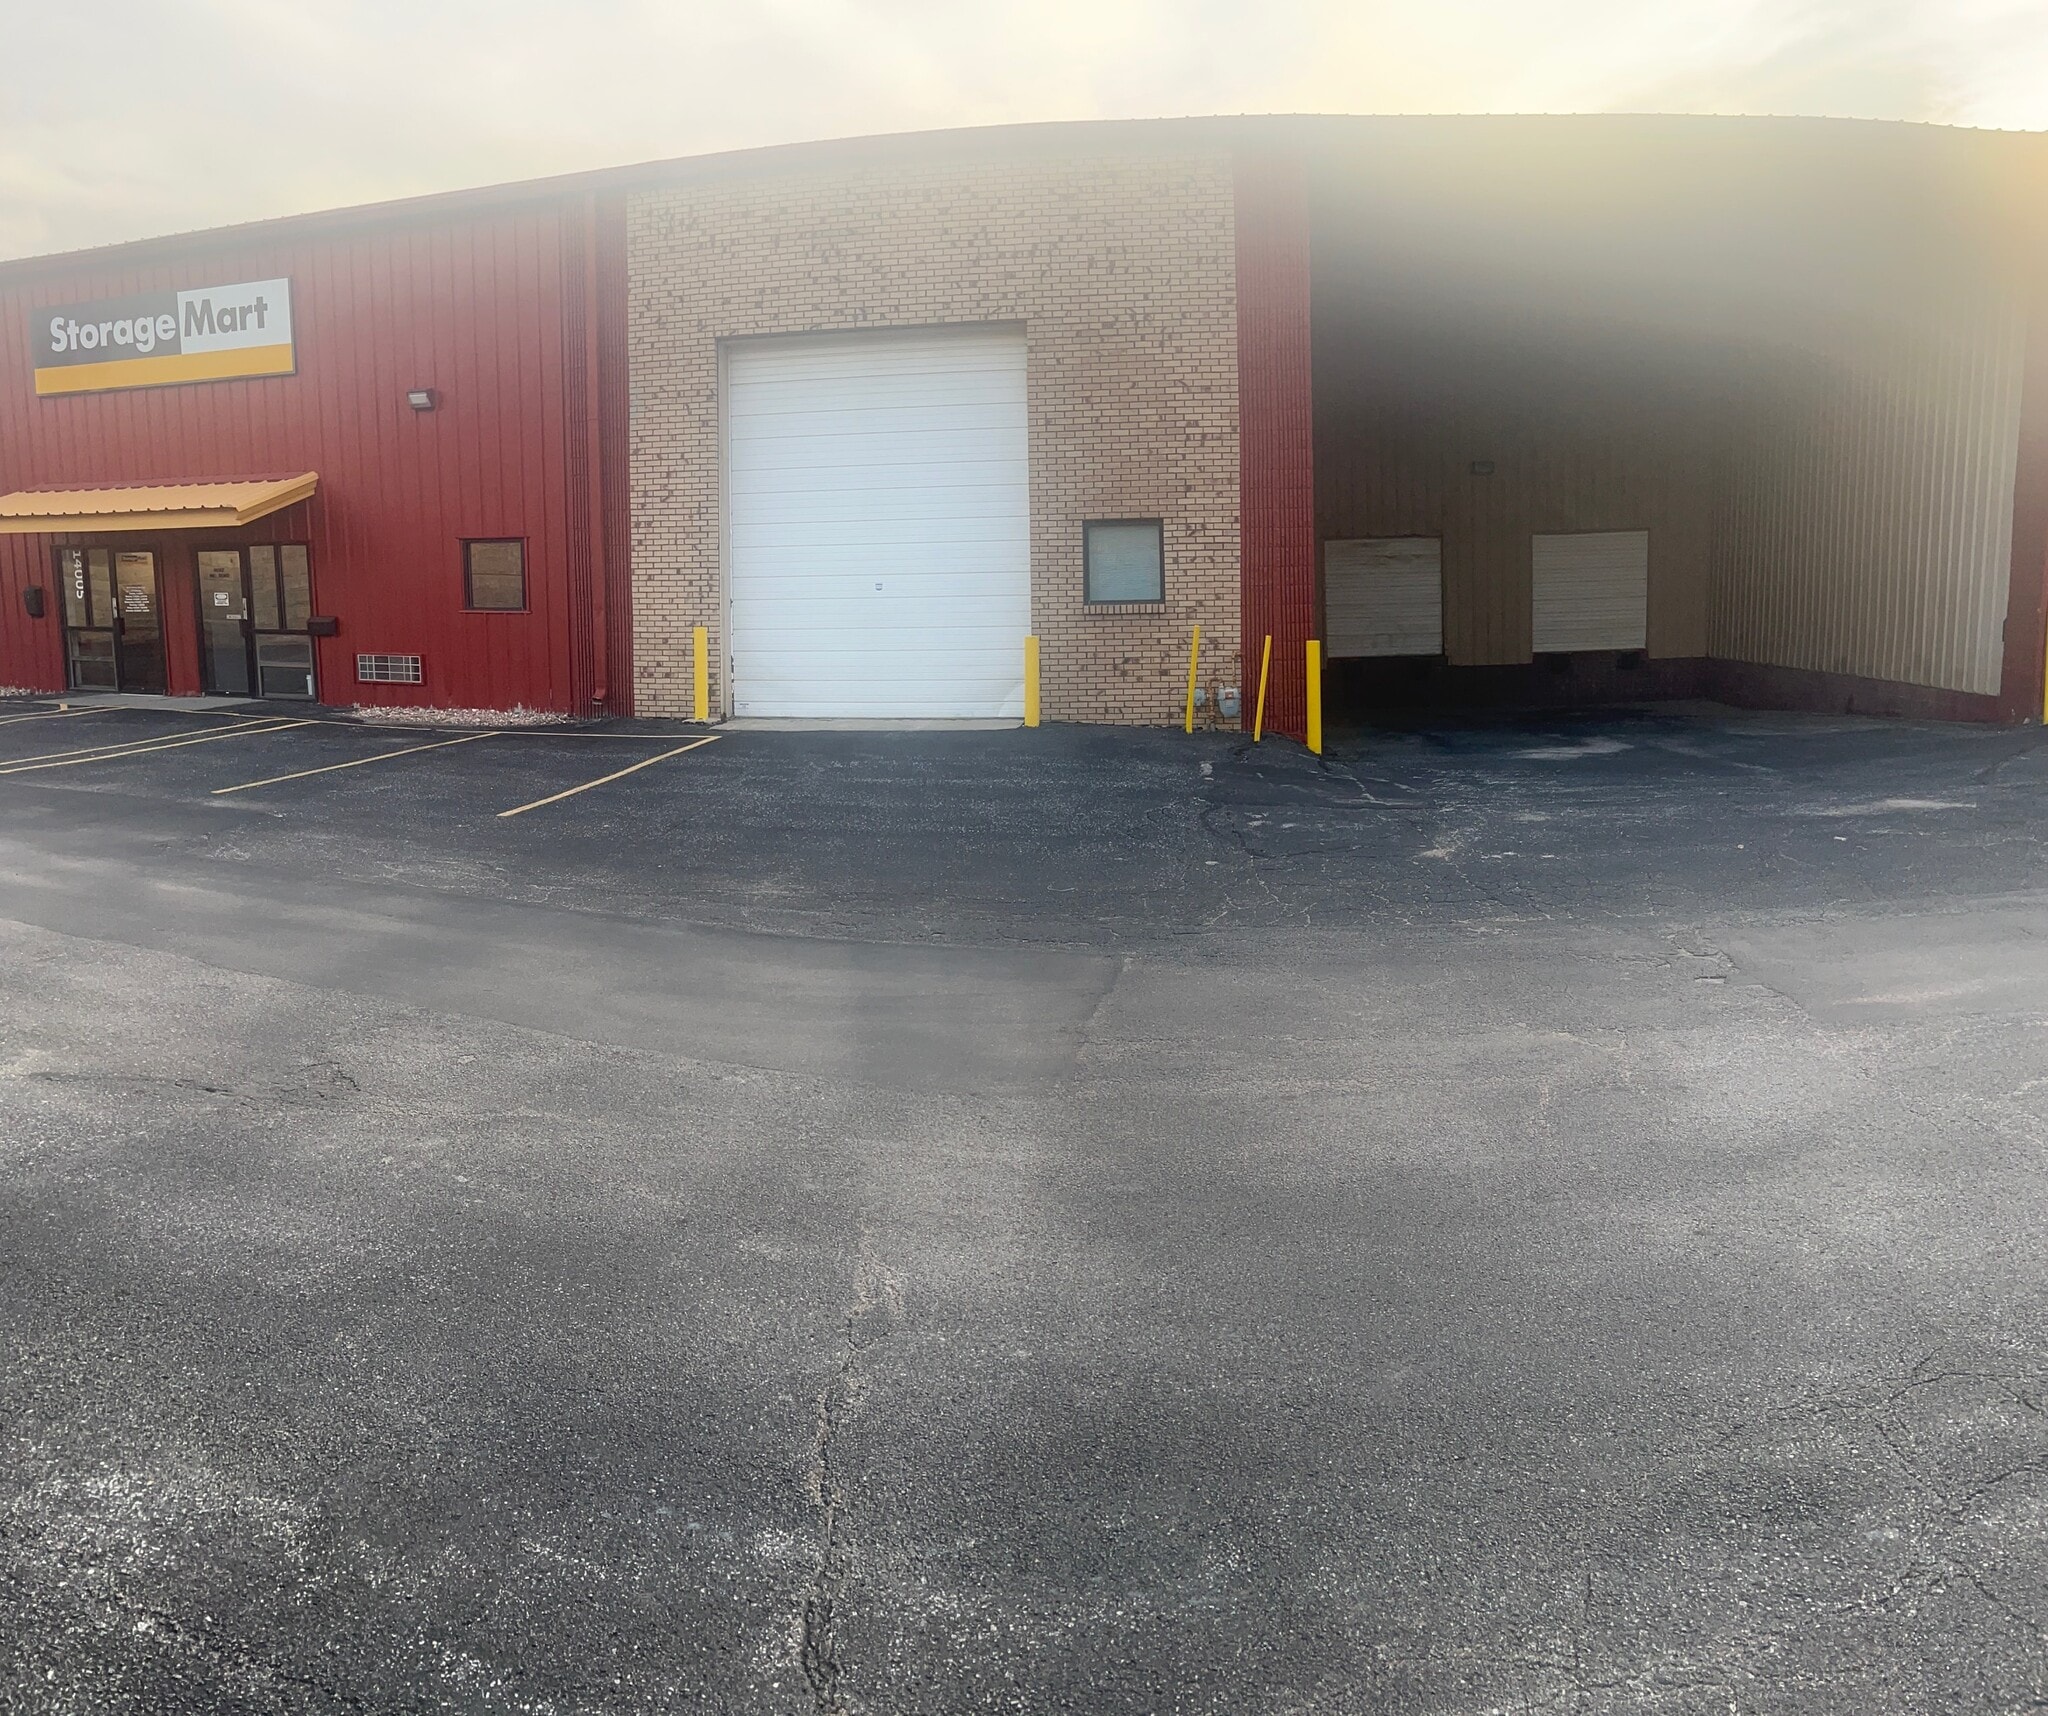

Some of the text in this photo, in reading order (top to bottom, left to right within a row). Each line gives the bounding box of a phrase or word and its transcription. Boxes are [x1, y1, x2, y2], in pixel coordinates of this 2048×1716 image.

[50, 296, 268, 353] Storage Mart
[72, 550, 84, 599] 14005
